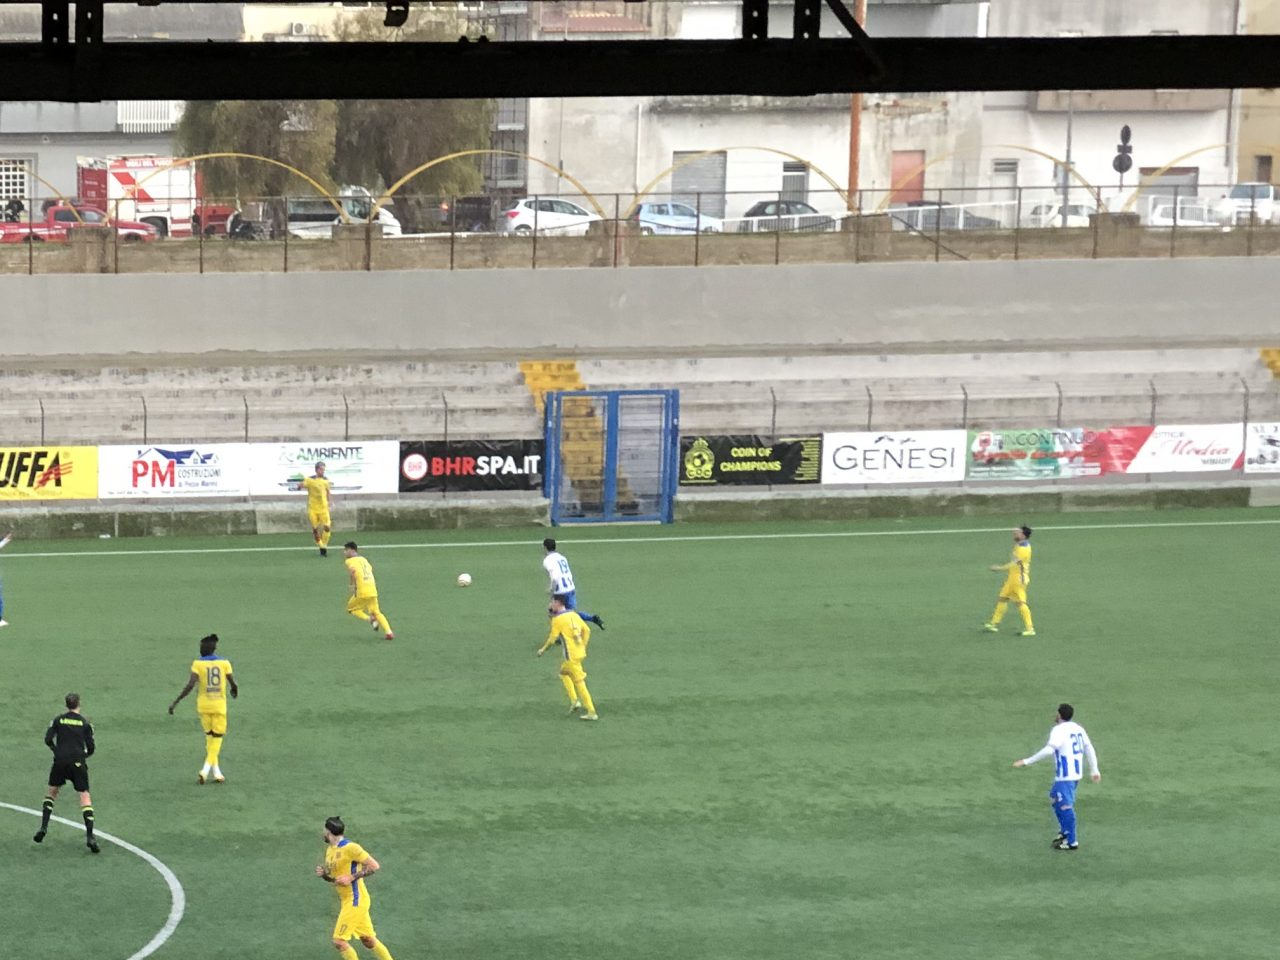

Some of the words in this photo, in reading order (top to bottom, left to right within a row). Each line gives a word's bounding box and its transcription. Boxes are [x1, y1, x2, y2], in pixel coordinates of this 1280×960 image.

[296, 447, 364, 461] AMBIENTE
[731, 447, 756, 457] COIN
[757, 447, 773, 457] OF
[832, 445, 955, 471] GENESI
[132, 460, 175, 488] PM
[431, 455, 541, 476] BHRSPA.IT
[720, 461, 782, 472] CHAMPIONS
[206, 666, 221, 687] 18
[1070, 732, 1084, 754] 20
